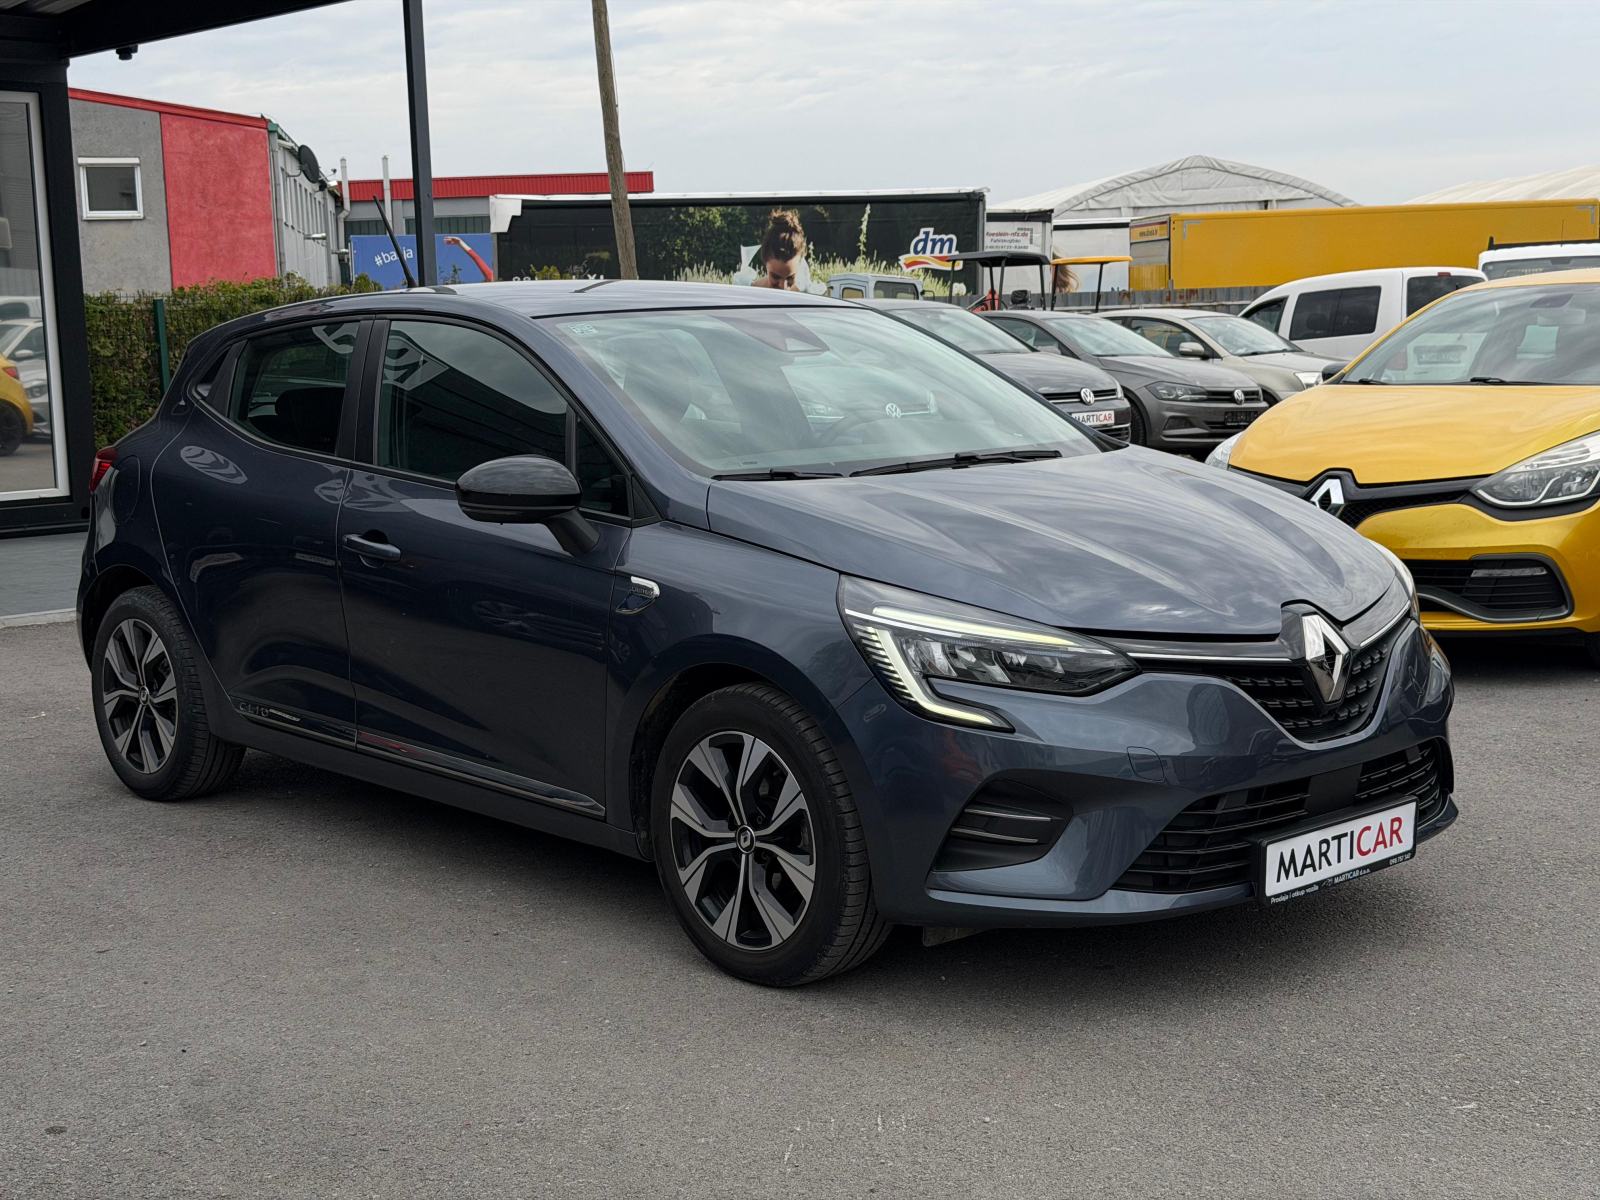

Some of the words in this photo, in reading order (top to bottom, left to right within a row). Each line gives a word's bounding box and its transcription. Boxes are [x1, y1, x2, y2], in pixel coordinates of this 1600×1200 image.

[912, 230, 955, 256] dm
[239, 702, 269, 717] CLIO
[1276, 816, 1403, 883] MARTICAR
[1334, 869, 1360, 884] MARTICAR
